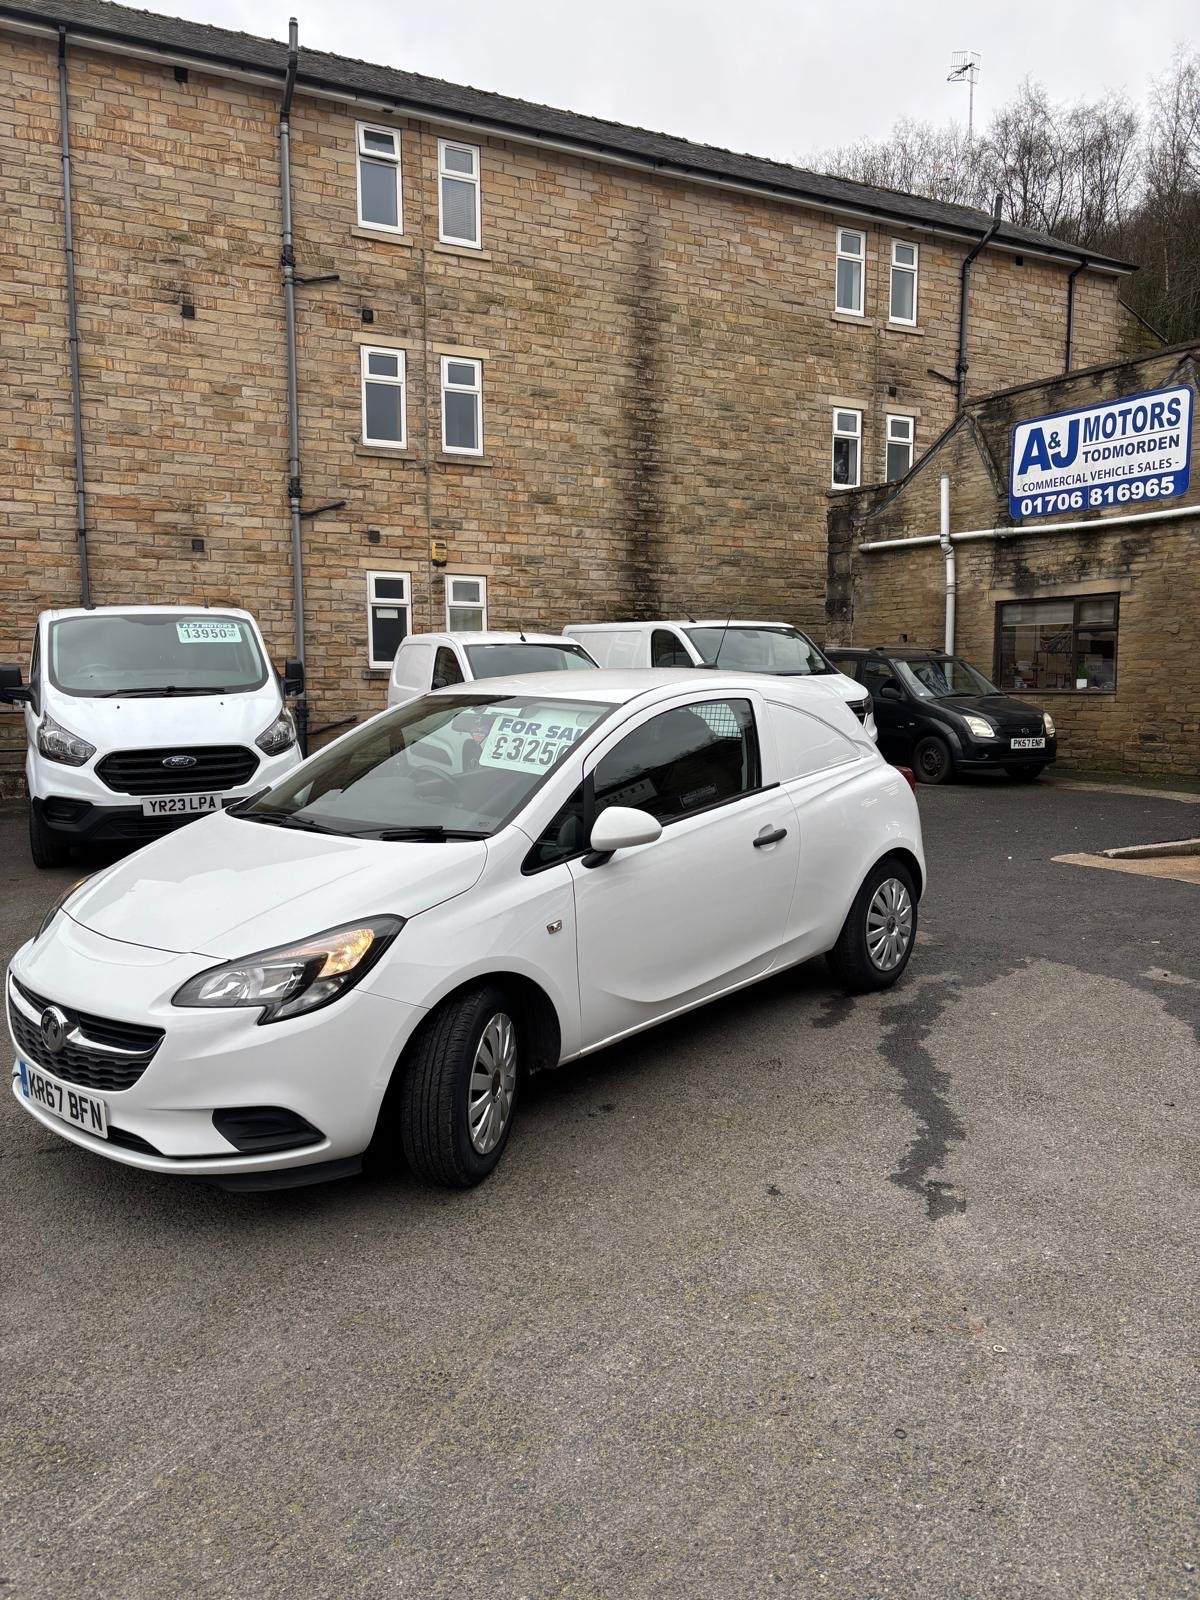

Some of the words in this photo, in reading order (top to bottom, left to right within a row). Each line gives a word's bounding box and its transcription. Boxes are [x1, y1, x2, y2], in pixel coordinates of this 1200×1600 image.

[1017, 418, 1080, 476] A&J
[1082, 397, 1182, 444] MOTORS
[1082, 434, 1180, 464] TODMORDEN
[1022, 472, 1088, 493] COMMERCIAL
[1090, 464, 1135, 481] VEHICLE
[1137, 457, 1173, 473] SALES
[1020, 491, 1083, 516] 01706
[1089, 475, 1176, 506] 816965
[183, 628, 227, 639] 13950
[498, 717, 542, 737] FOR
[545, 725, 584, 741] SAL
[1013, 738, 1031, 748] PK57
[149, 798, 186, 813] YR23
[189, 795, 216, 810] LPA
[28, 1070, 63, 1113] KR67
[67, 1090, 103, 1132] BFN
